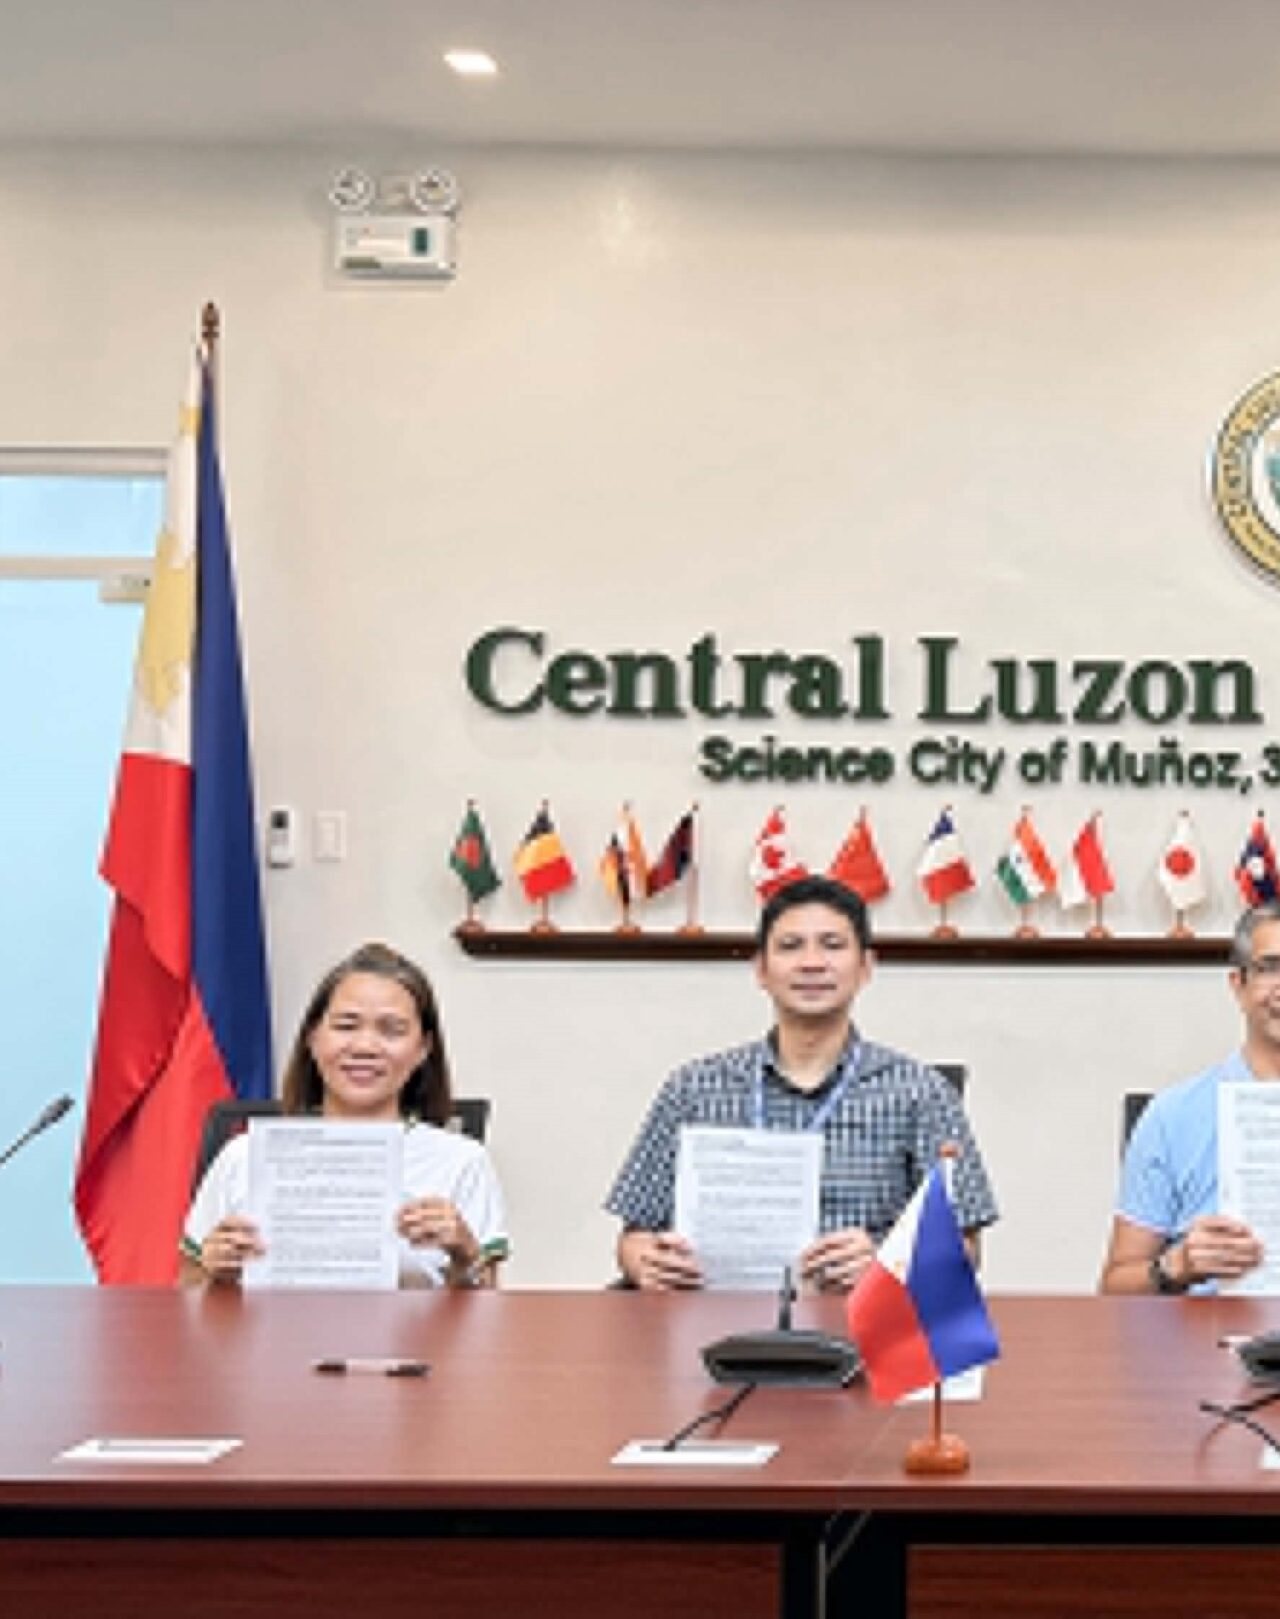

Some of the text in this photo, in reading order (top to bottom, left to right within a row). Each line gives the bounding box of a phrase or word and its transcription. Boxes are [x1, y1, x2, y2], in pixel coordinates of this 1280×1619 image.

[465, 627, 891, 721] Central
[916, 635, 1264, 726] Luzon
[699, 735, 896, 784] Science
[908, 735, 1005, 795] City
[1018, 736, 1068, 784] of
